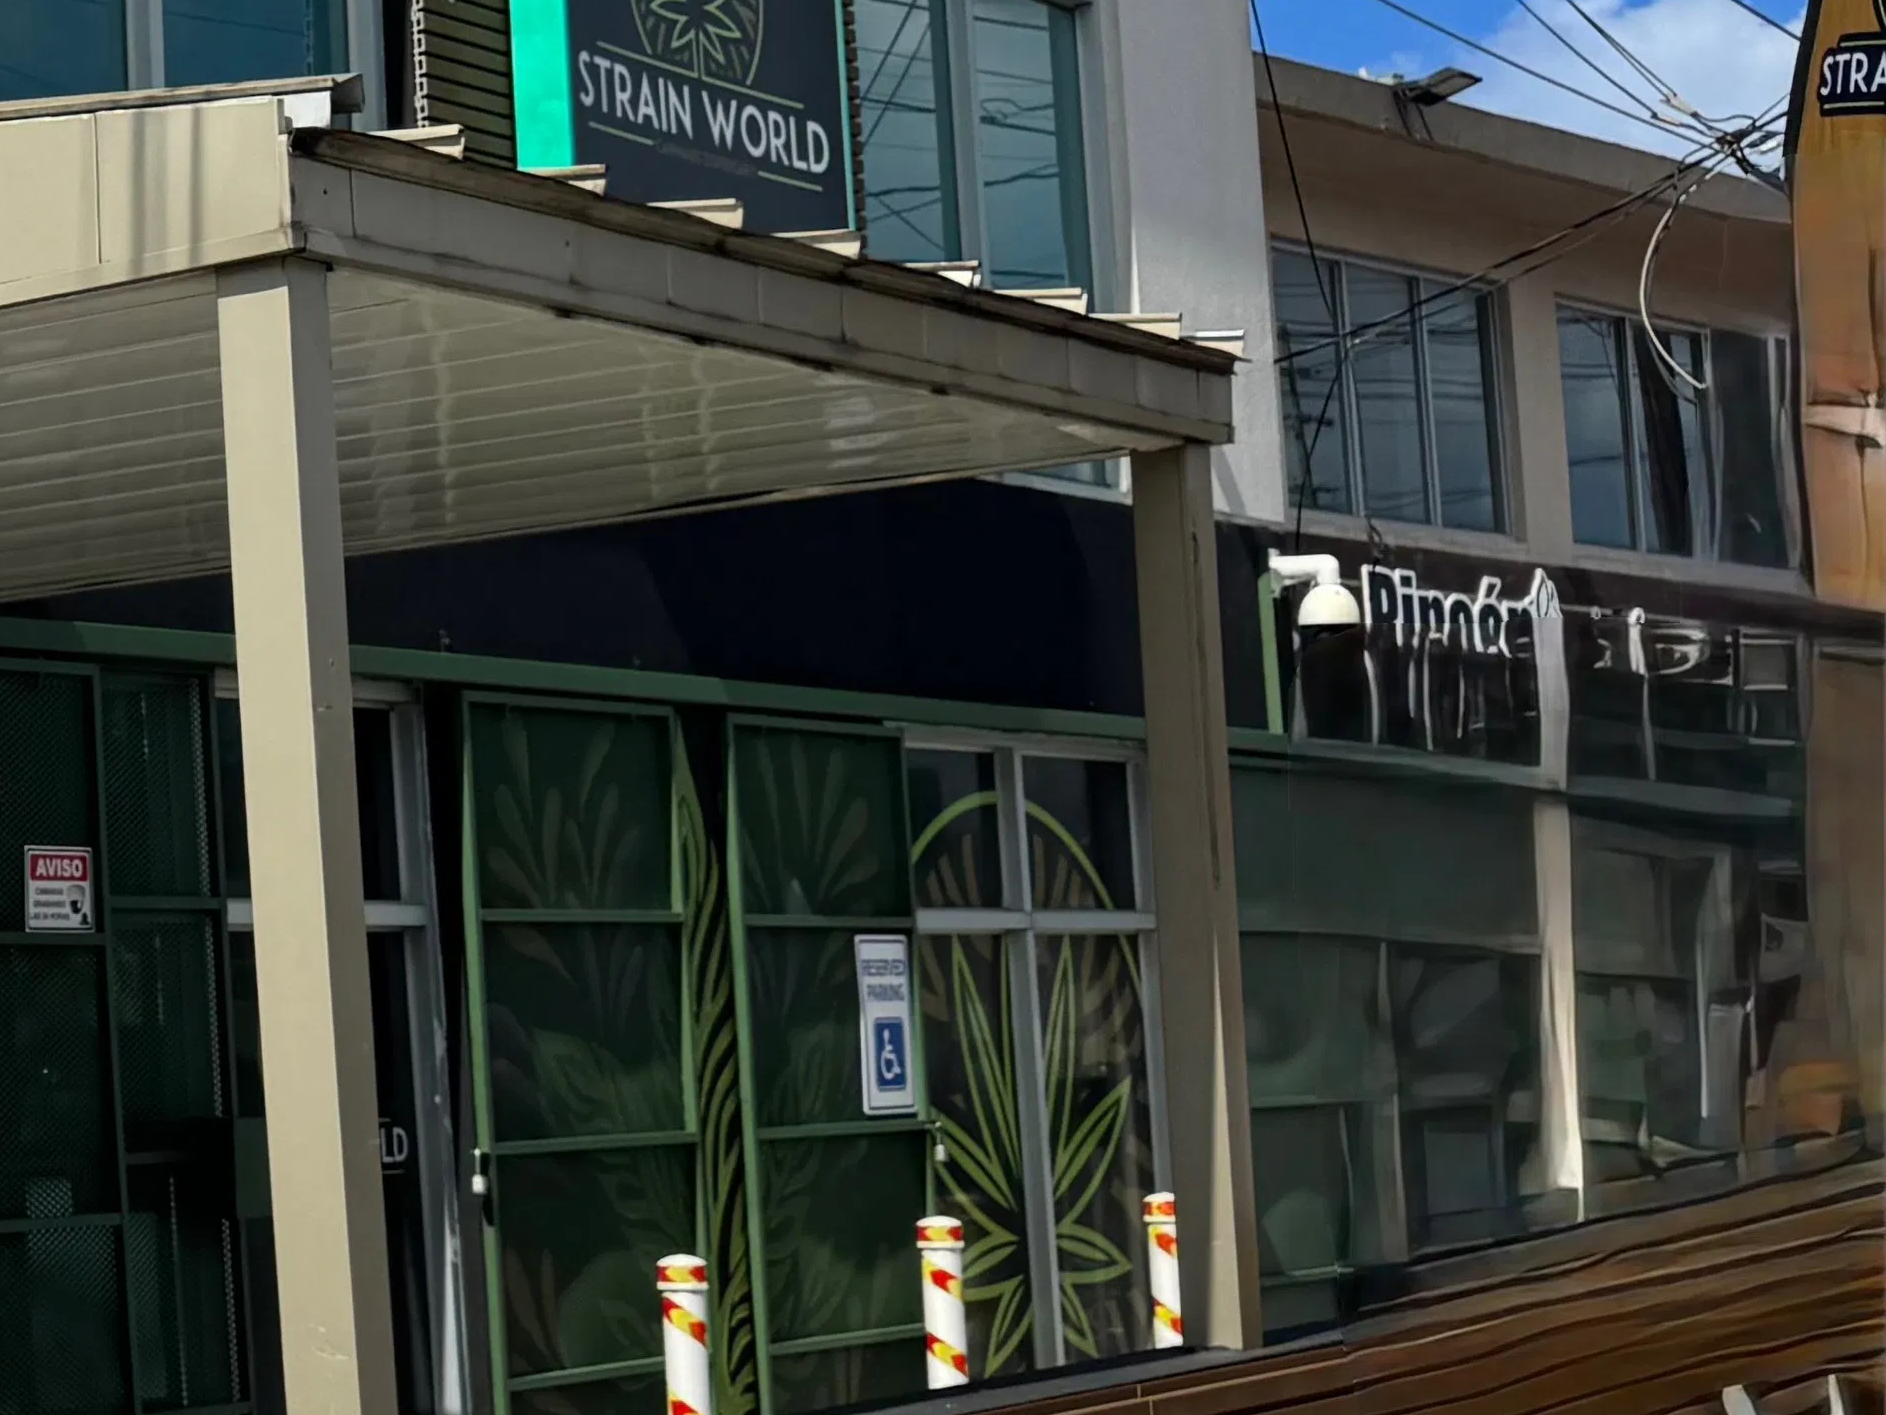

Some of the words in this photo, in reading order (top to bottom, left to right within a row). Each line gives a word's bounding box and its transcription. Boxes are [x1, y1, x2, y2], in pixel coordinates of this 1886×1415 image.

[578, 50, 694, 141] STRAIN
[703, 90, 829, 175] WORLD
[35, 857, 83, 878] AVISO
